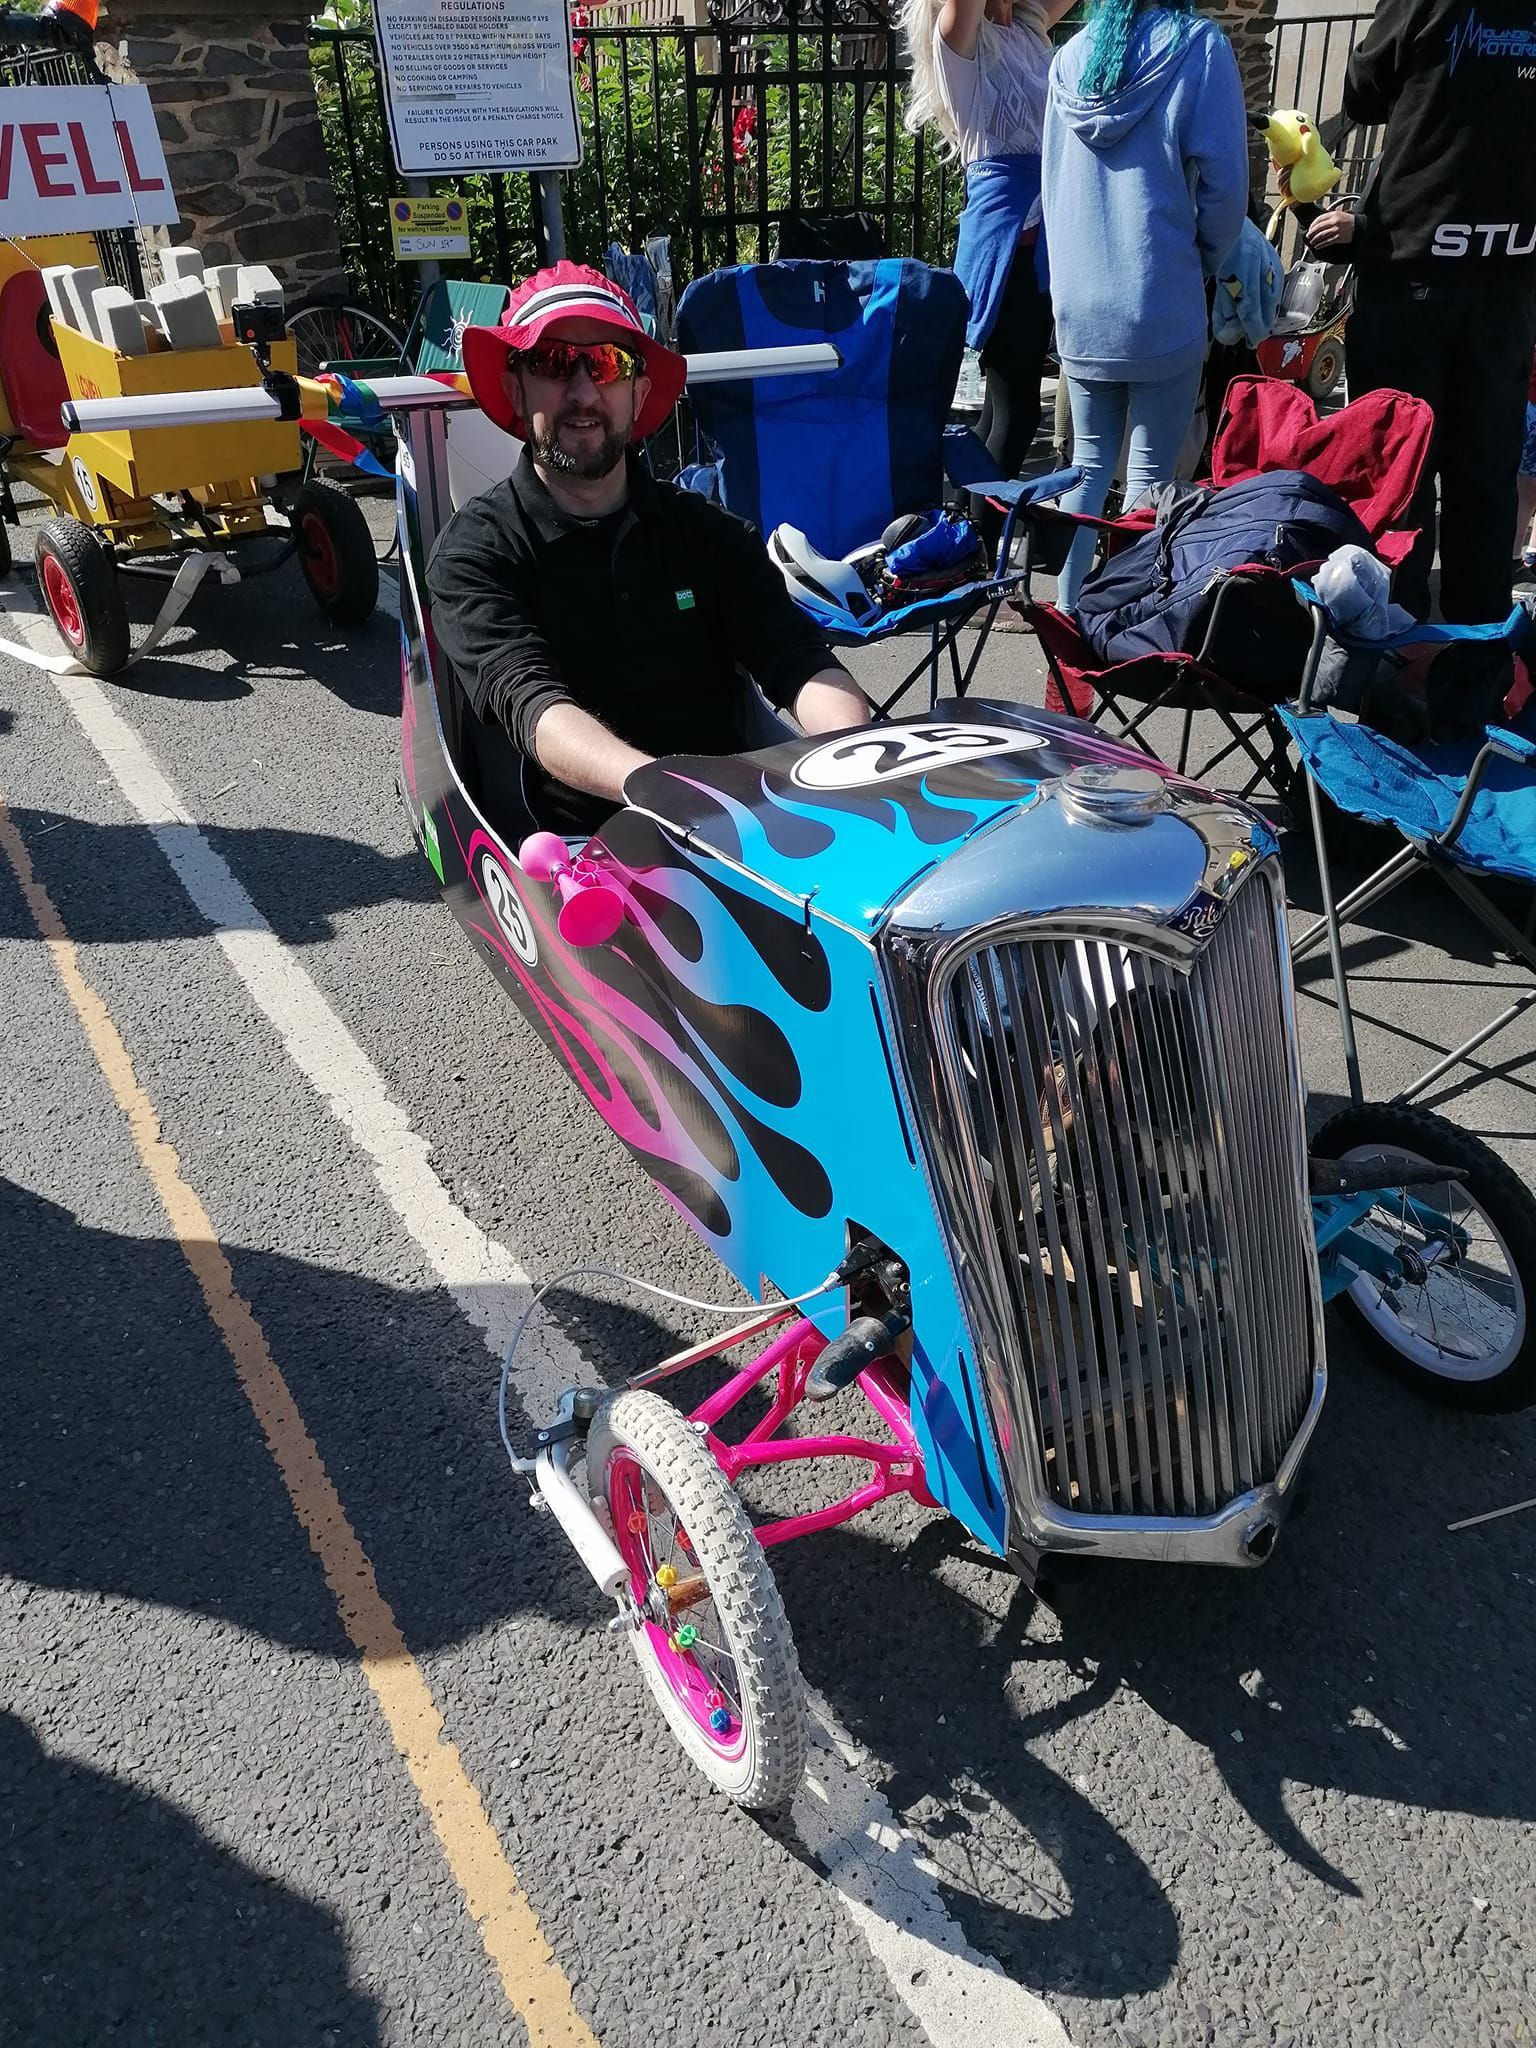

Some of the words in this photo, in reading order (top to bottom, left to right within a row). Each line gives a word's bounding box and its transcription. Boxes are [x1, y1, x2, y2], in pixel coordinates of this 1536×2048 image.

[440, 1, 505, 10] REGULATIONS
[501, 105, 544, 113] REGULATIONS
[419, 141, 462, 151] PERSONS
[464, 139, 493, 149] USING
[495, 139, 515, 148] THIS
[516, 138, 534, 147] CAR
[536, 137, 558, 146] PARK
[434, 152, 447, 161] DO
[449, 151, 461, 160] SO
[464, 151, 474, 159] AT
[476, 150, 502, 159] THEIR
[503, 149, 525, 158] OWN
[527, 148, 547, 157] RISK
[417, 203, 440, 211] Parking
[412, 211, 446, 220] Suspended
[416, 238, 436, 250] SUN
[77, 466, 94, 501] 15
[833, 727, 1009, 775] 25
[490, 868, 528, 951] 25
